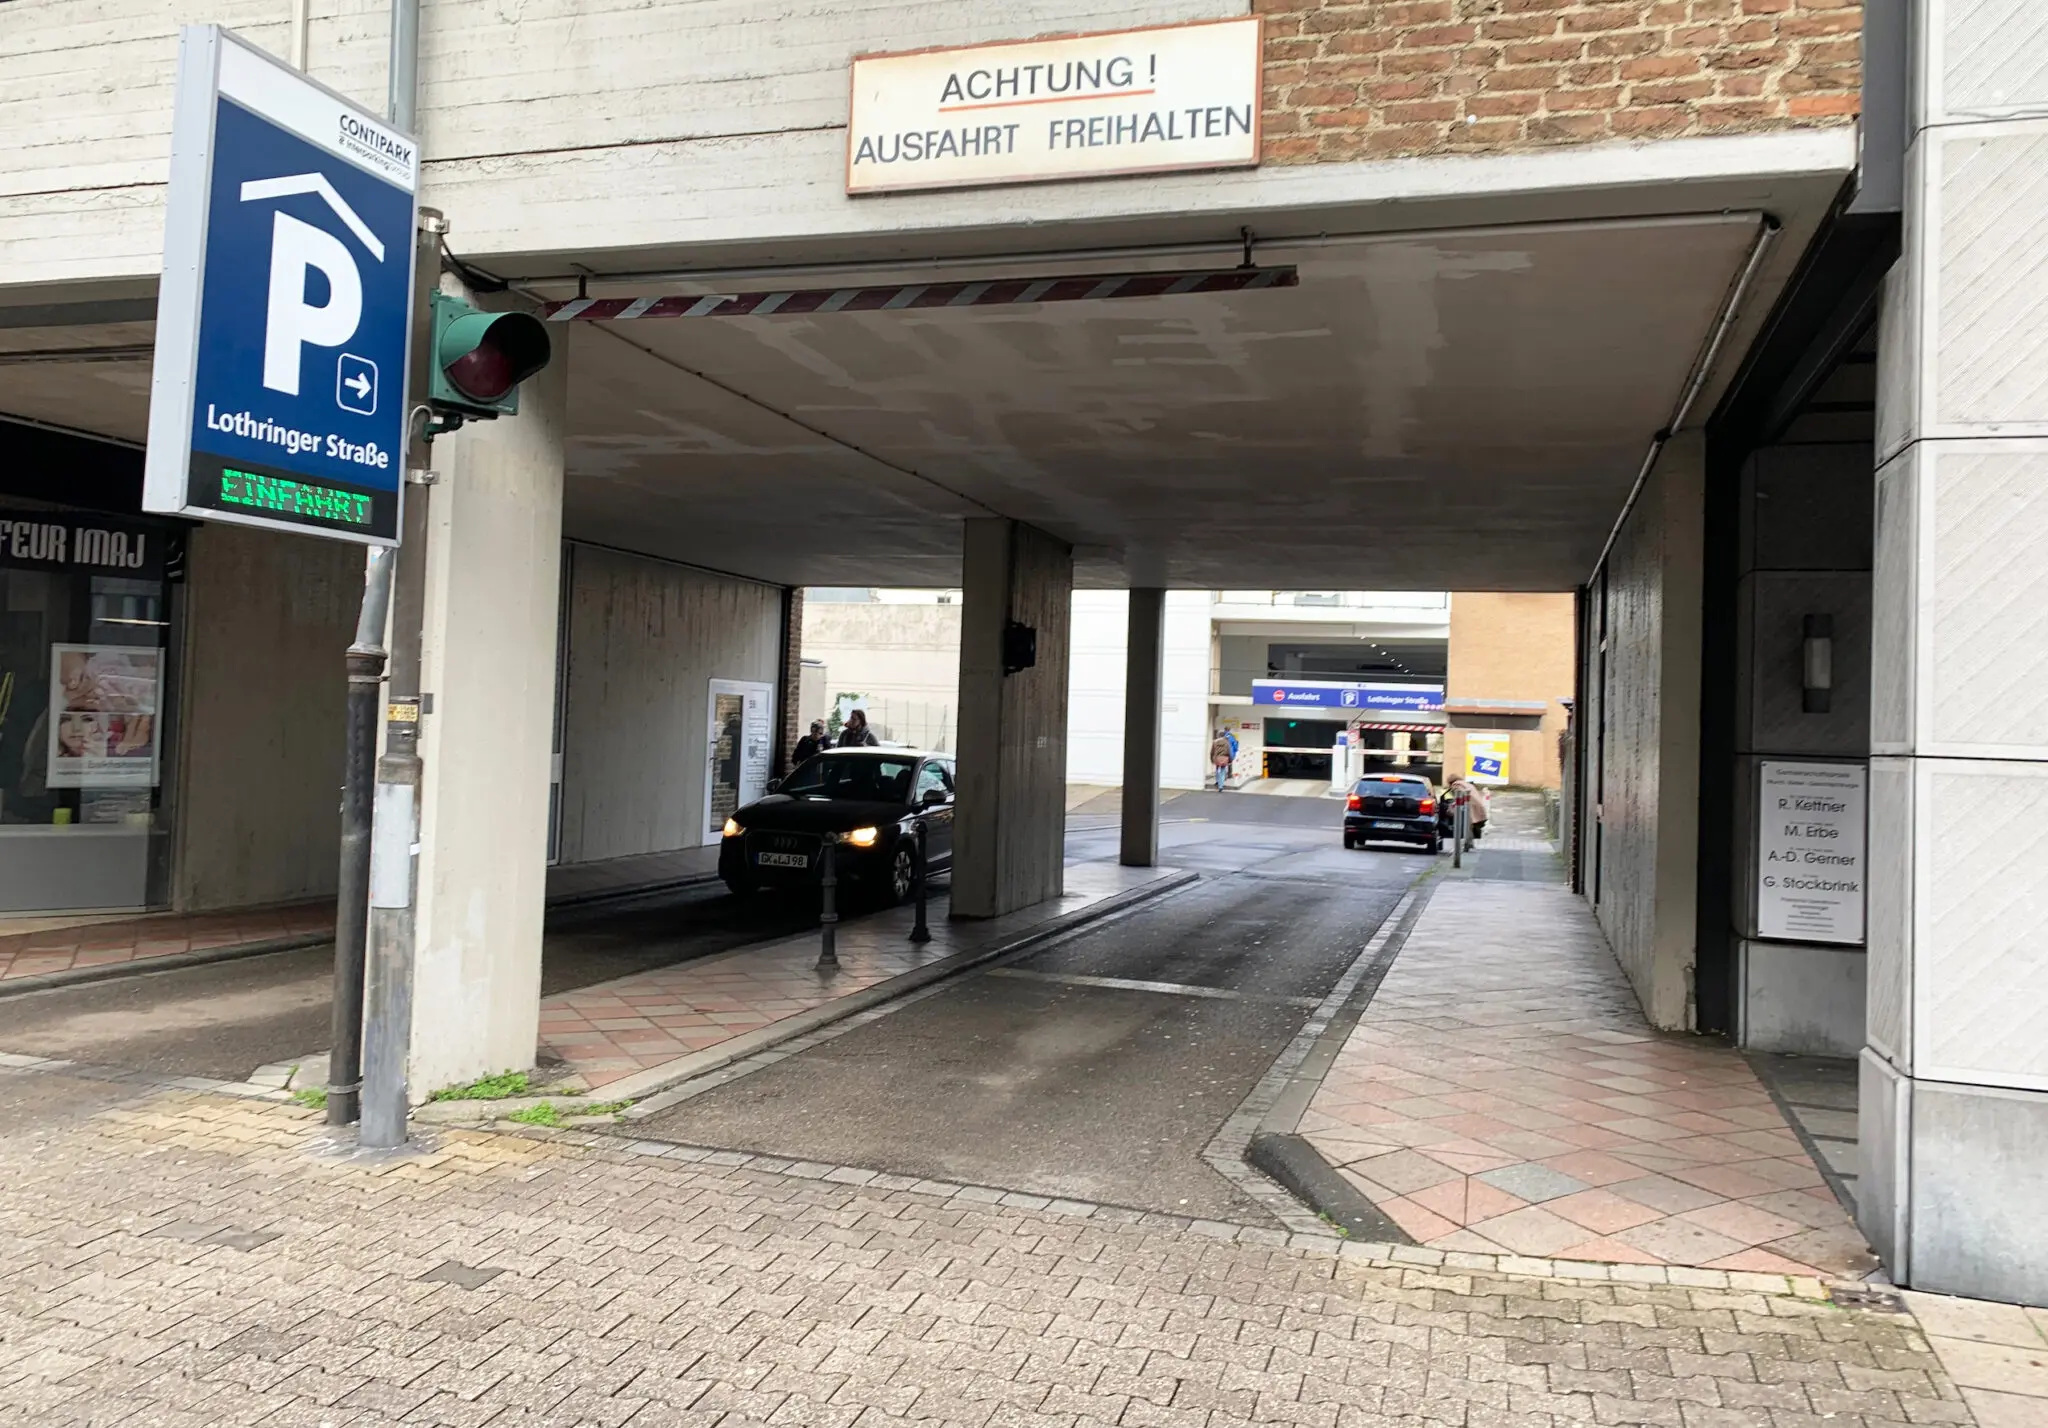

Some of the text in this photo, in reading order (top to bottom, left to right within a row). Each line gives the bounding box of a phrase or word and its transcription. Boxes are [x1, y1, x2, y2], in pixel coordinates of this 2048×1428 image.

[940, 55, 1133, 103] ACHTUNG
[339, 114, 412, 166] CONTIPARK
[853, 103, 1253, 166] AUSFAHRT FREIHALTEN
[263, 209, 363, 397] P
[207, 403, 390, 469] Lothringer Straße
[220, 467, 371, 524] EINFAHRT
[73, 527, 145, 569] IMAJ
[1778, 798, 1847, 813] R. Kettner
[1784, 824, 1839, 839] M. Erbe
[1804, 851, 1856, 867] Gerner
[1763, 875, 1859, 893] G. Stockbrink
